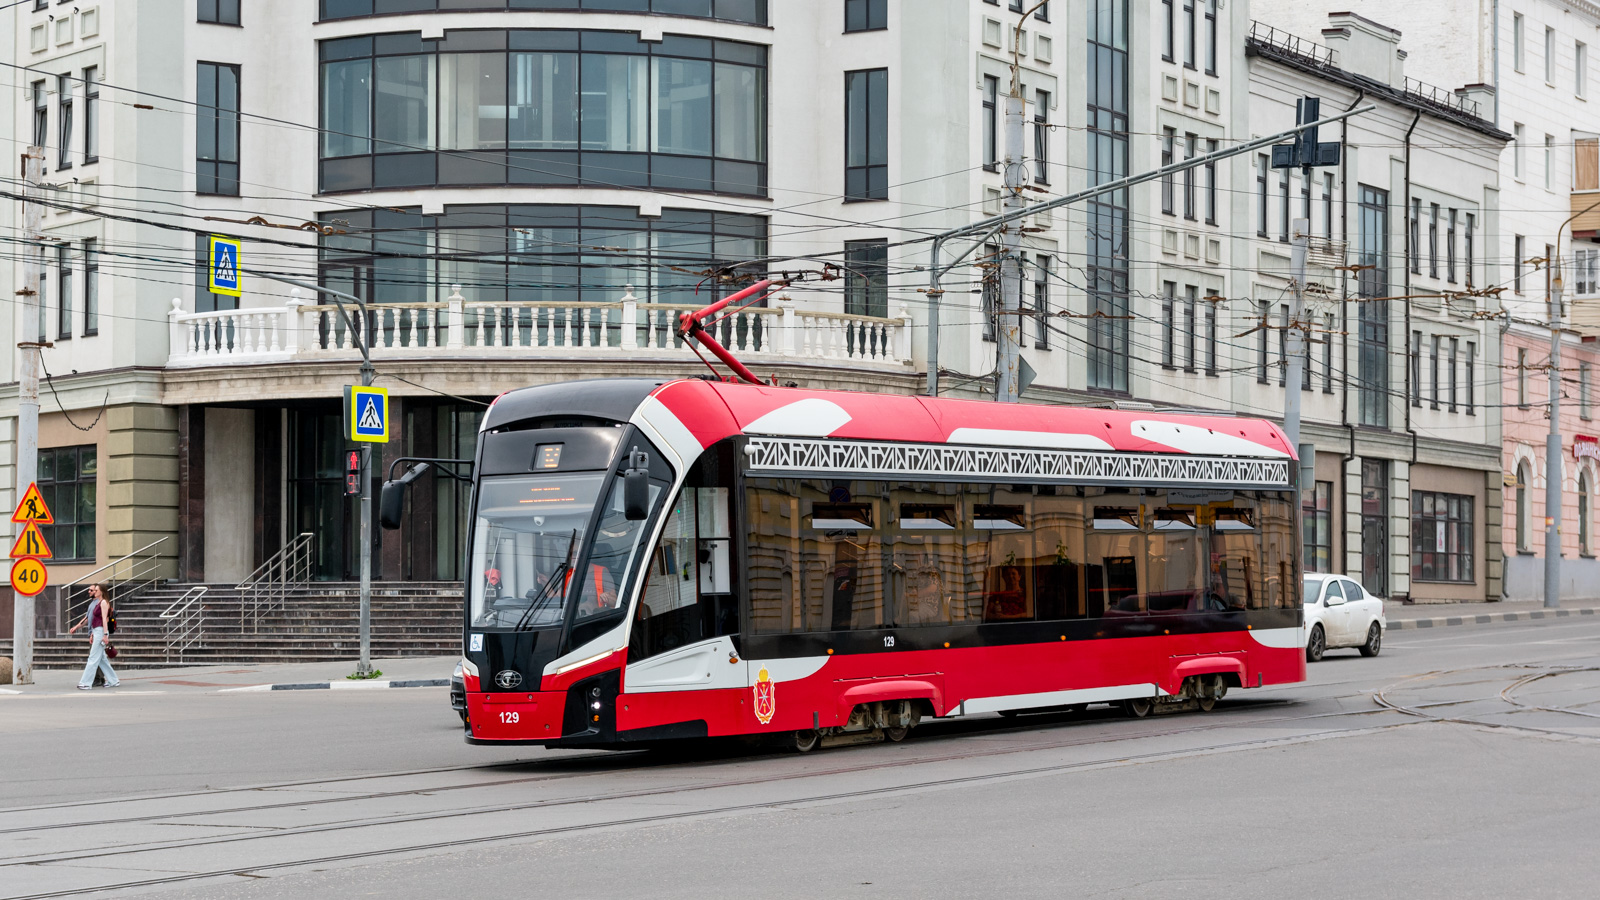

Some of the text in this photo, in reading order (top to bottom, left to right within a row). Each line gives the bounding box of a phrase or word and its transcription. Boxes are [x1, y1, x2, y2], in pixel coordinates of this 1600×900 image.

[18, 569, 39, 583] 40
[883, 636, 895, 647] 129
[499, 712, 519, 723] 129
